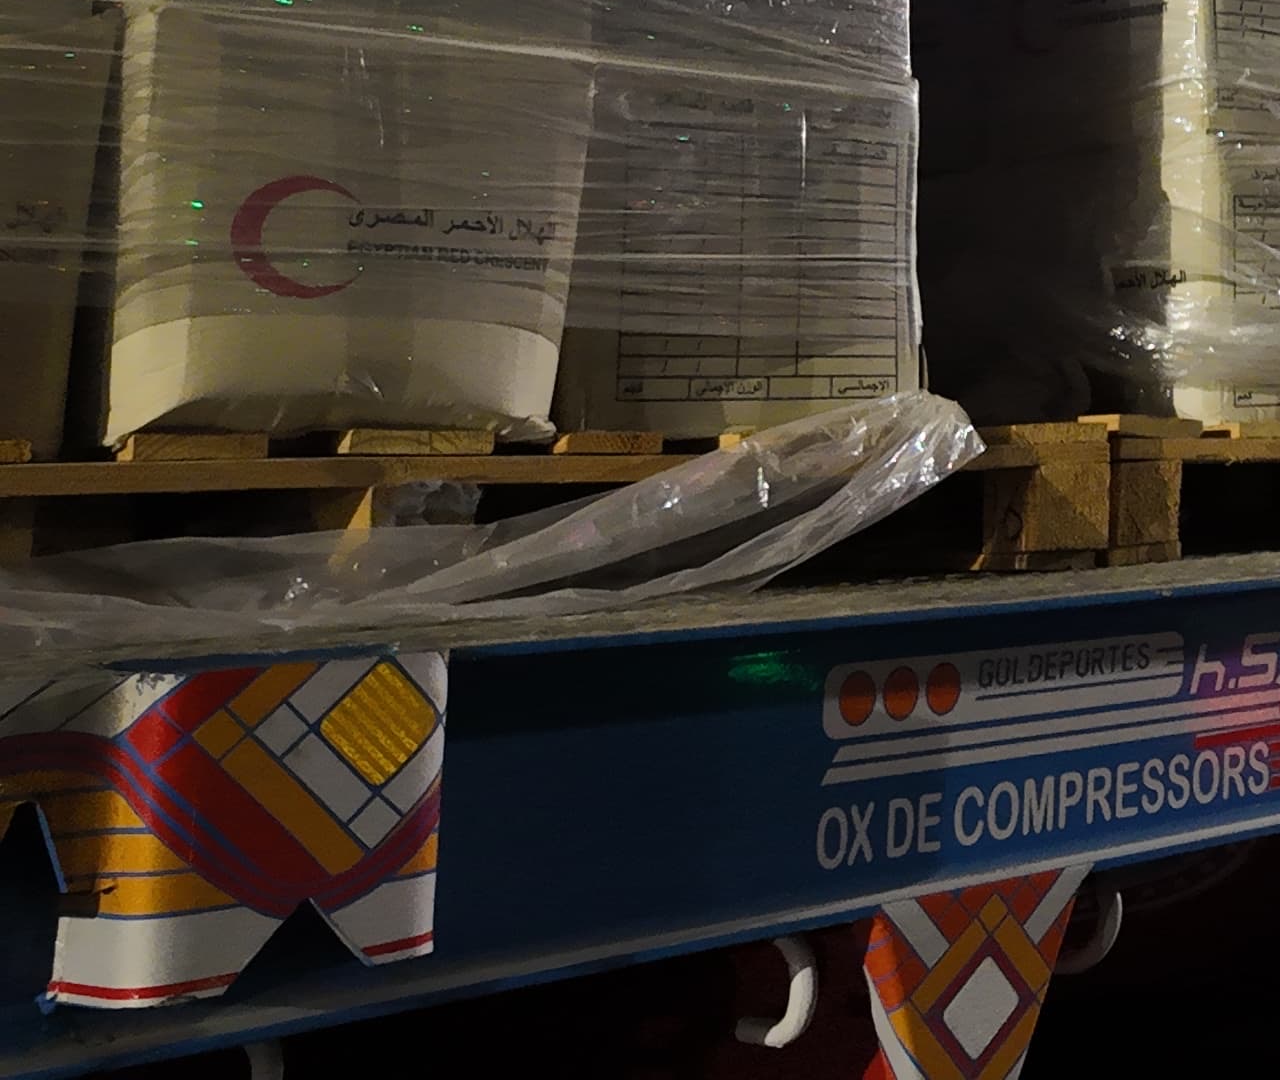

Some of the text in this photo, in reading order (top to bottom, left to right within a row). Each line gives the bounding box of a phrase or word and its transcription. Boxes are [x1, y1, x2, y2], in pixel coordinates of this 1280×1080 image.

[815, 741, 1271, 870] OX DE COMPRESSORS
